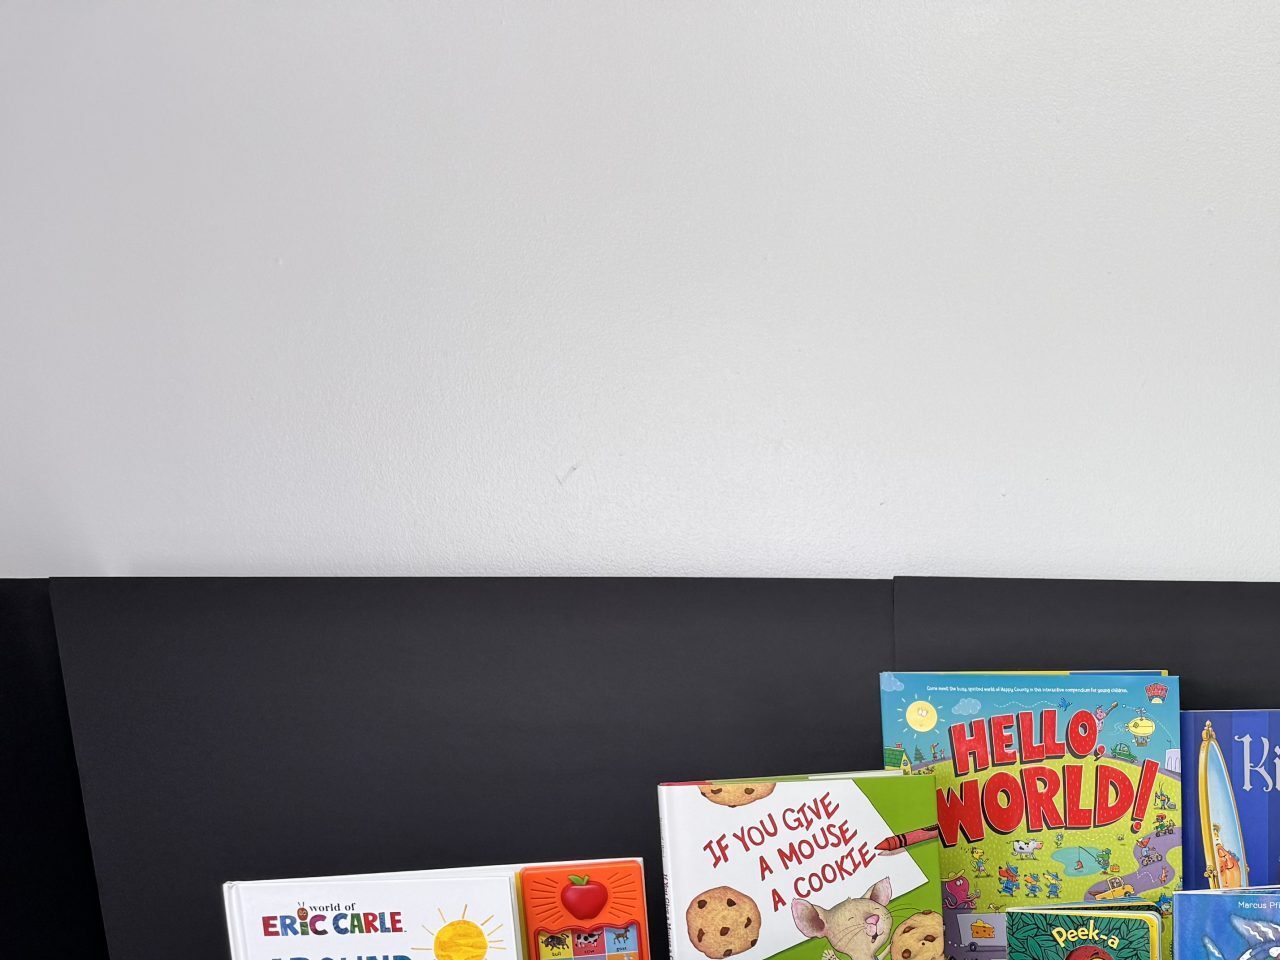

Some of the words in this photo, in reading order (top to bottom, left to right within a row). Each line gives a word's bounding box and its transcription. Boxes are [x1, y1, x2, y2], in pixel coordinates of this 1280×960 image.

[950, 709, 1106, 777] HELLO,
[703, 833, 729, 868] IF
[733, 813, 778, 852] YOU
[782, 791, 840, 831] GIVE
[937, 759, 1160, 848] WORLD!
[758, 855, 773, 881] A
[777, 820, 858, 870] MOUSE
[771, 888, 786, 912] A
[793, 841, 876, 898] COOKIE
[309, 903, 341, 912] world
[344, 902, 356, 912] of
[332, 912, 403, 935] CARLE
[1052, 920, 1120, 949] Peek-a
[1238, 901, 1267, 910] Marcus
